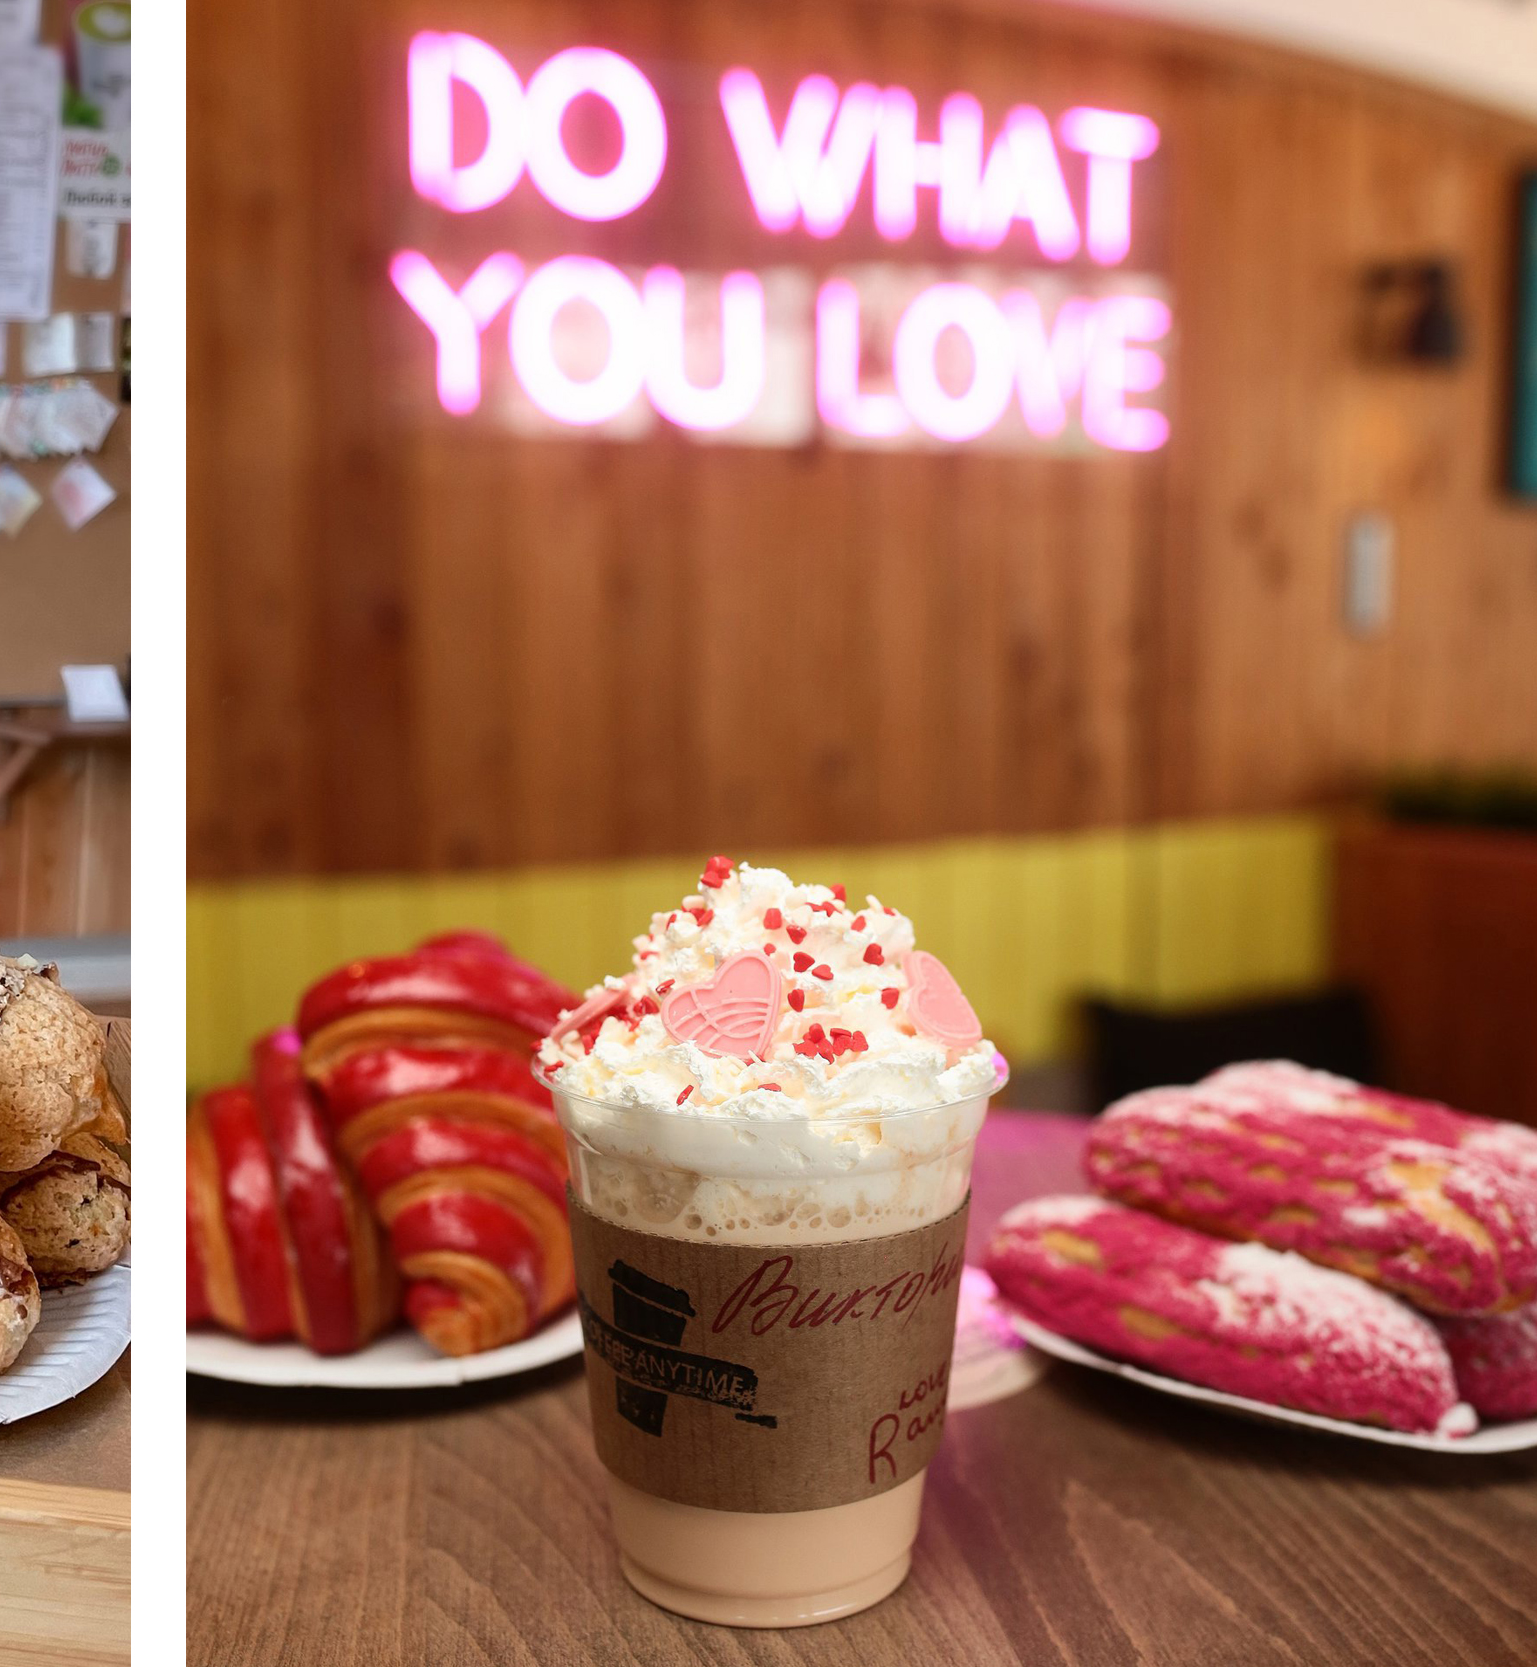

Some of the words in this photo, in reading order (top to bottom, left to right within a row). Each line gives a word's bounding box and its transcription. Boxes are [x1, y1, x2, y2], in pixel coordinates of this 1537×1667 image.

[406, 30, 667, 221] DO
[720, 66, 1160, 265] WHAT
[390, 249, 765, 430] YOU
[816, 279, 1172, 452] LOVE
